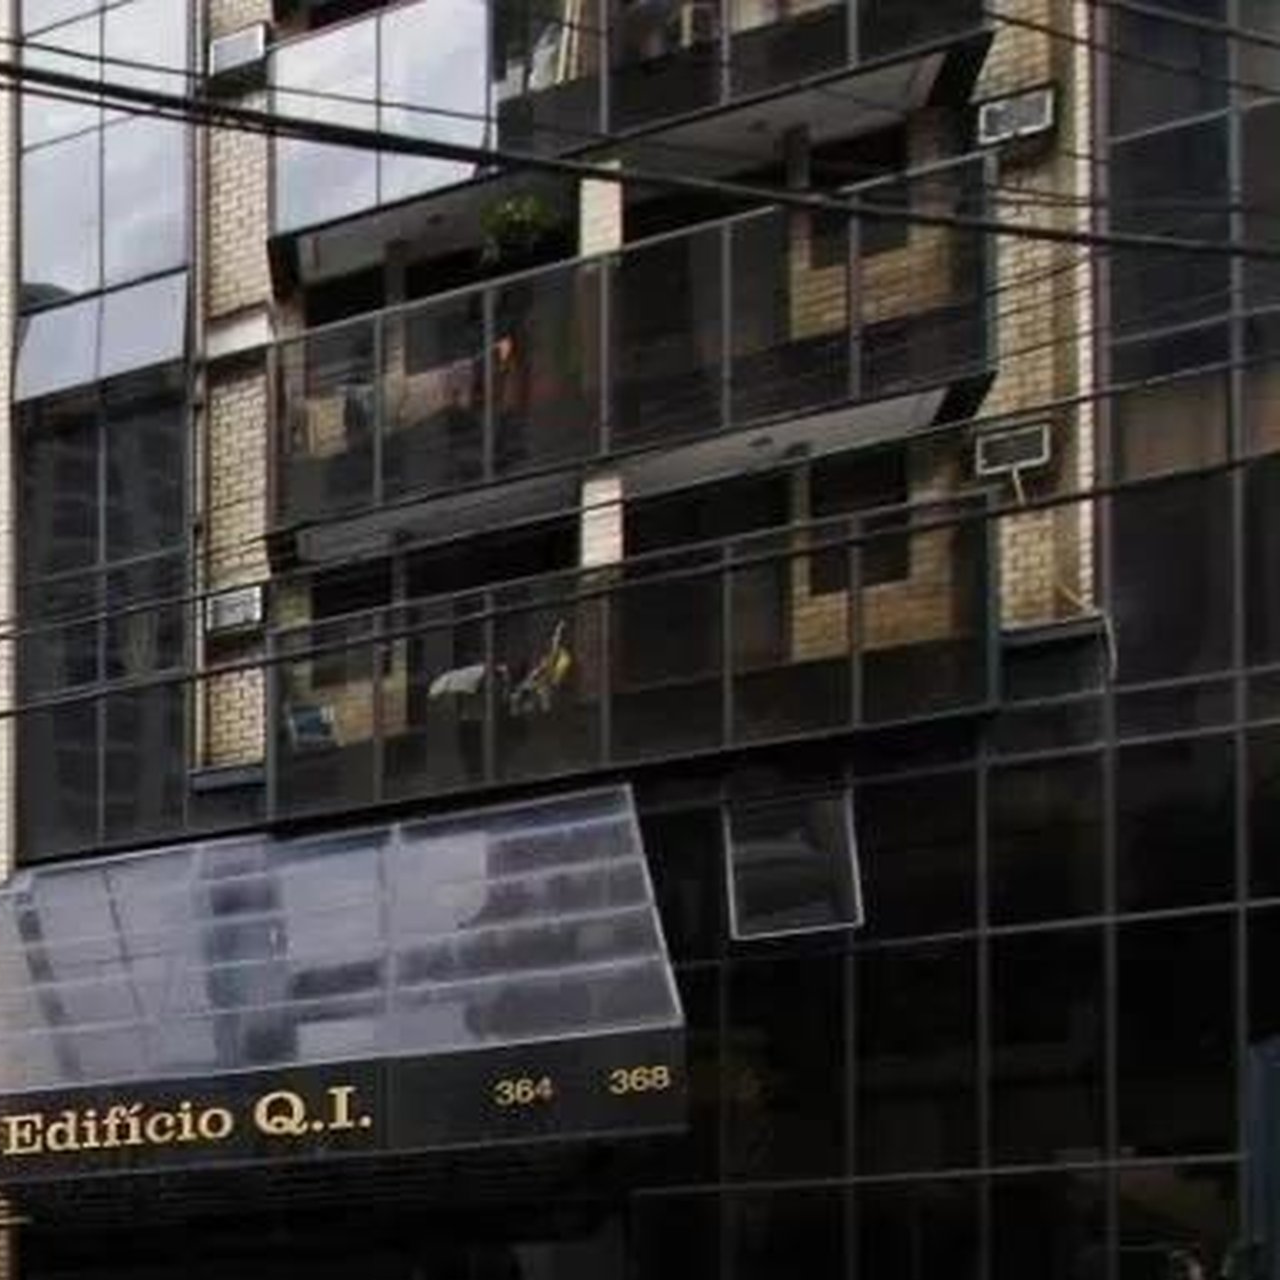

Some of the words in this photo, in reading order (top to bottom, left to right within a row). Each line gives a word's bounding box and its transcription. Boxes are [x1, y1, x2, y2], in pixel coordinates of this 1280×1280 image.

[493, 1076, 554, 1105] 364
[608, 1065, 671, 1095] 368
[2, 1101, 234, 1156] Edifício
[254, 1085, 374, 1136] Q.I.
